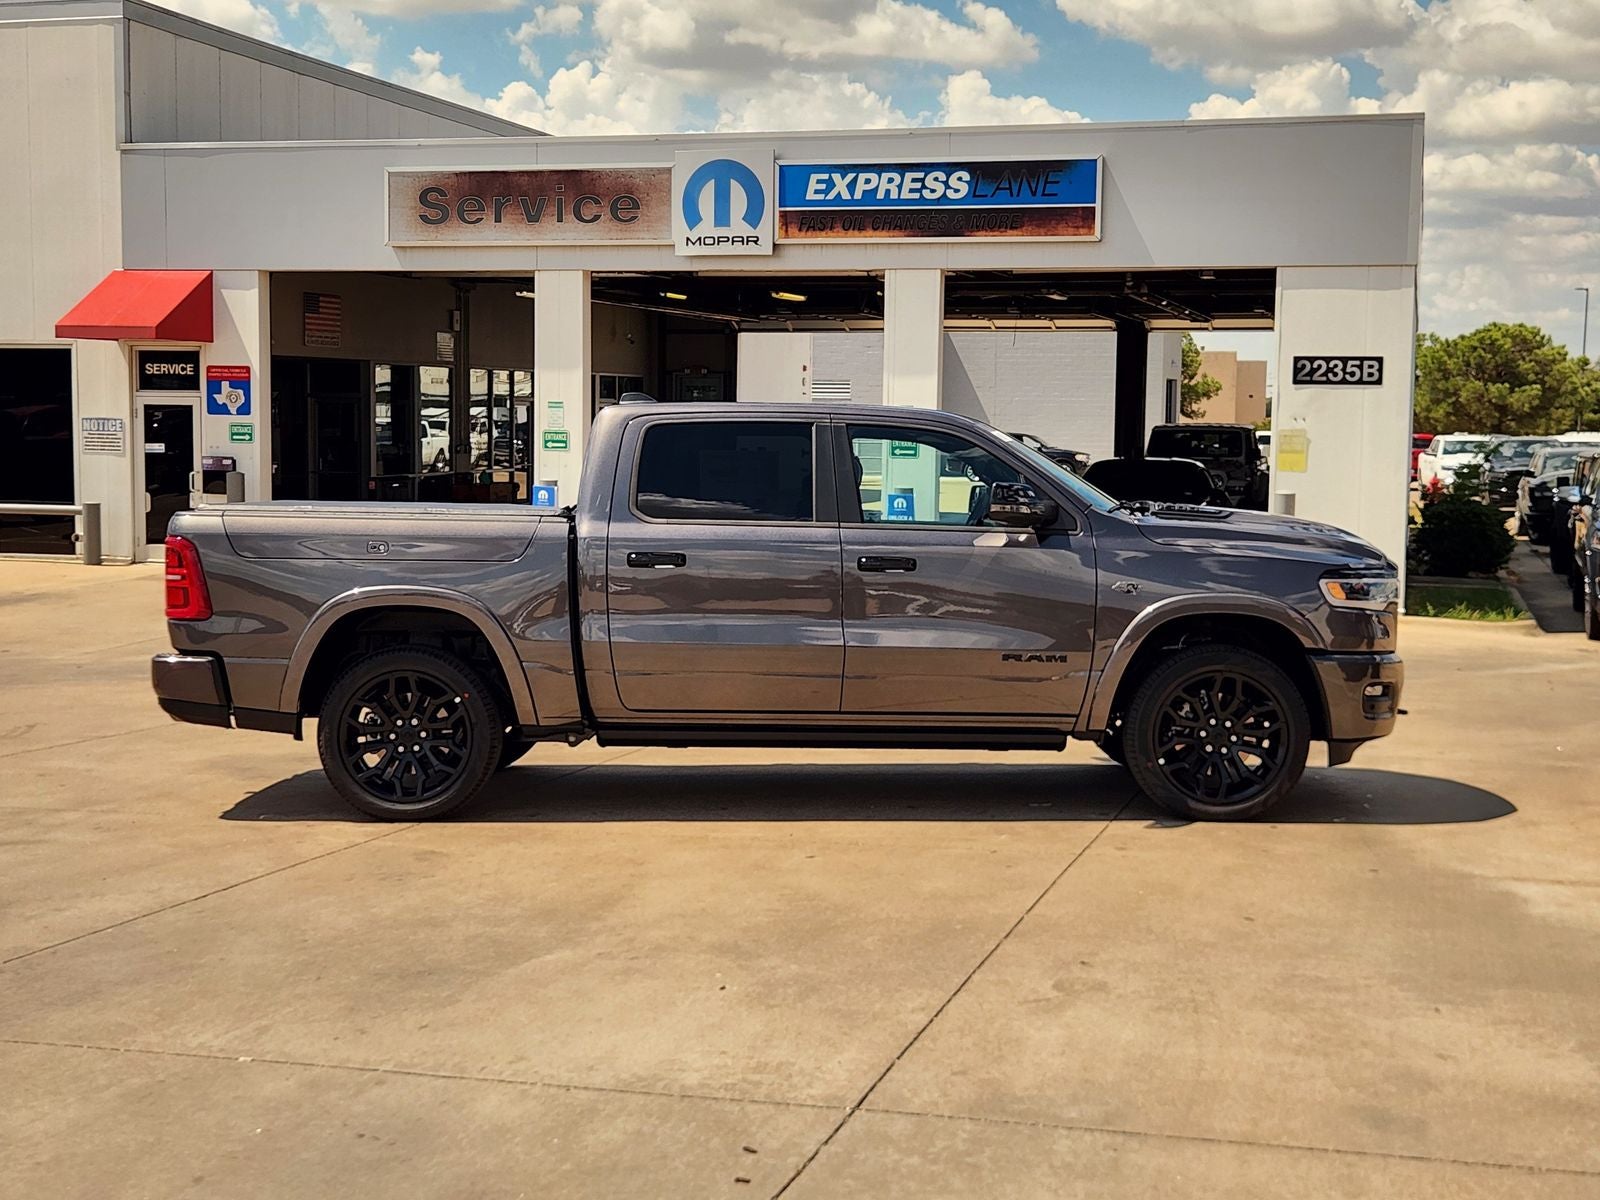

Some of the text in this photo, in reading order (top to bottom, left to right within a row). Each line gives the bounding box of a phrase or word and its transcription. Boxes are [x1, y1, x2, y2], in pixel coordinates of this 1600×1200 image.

[805, 168, 1064, 200] EXPRESS LANE
[417, 184, 642, 226] Service
[798, 214, 837, 233] FAST
[841, 214, 867, 232] OIL
[871, 213, 949, 232] CHANGES
[968, 212, 1022, 231] MORE
[685, 234, 761, 247] MOPAR
[144, 363, 195, 375] SERVICE
[1295, 359, 1380, 382] 2235B
[82, 419, 122, 431] NOTICE
[1002, 653, 1068, 663] RAM
